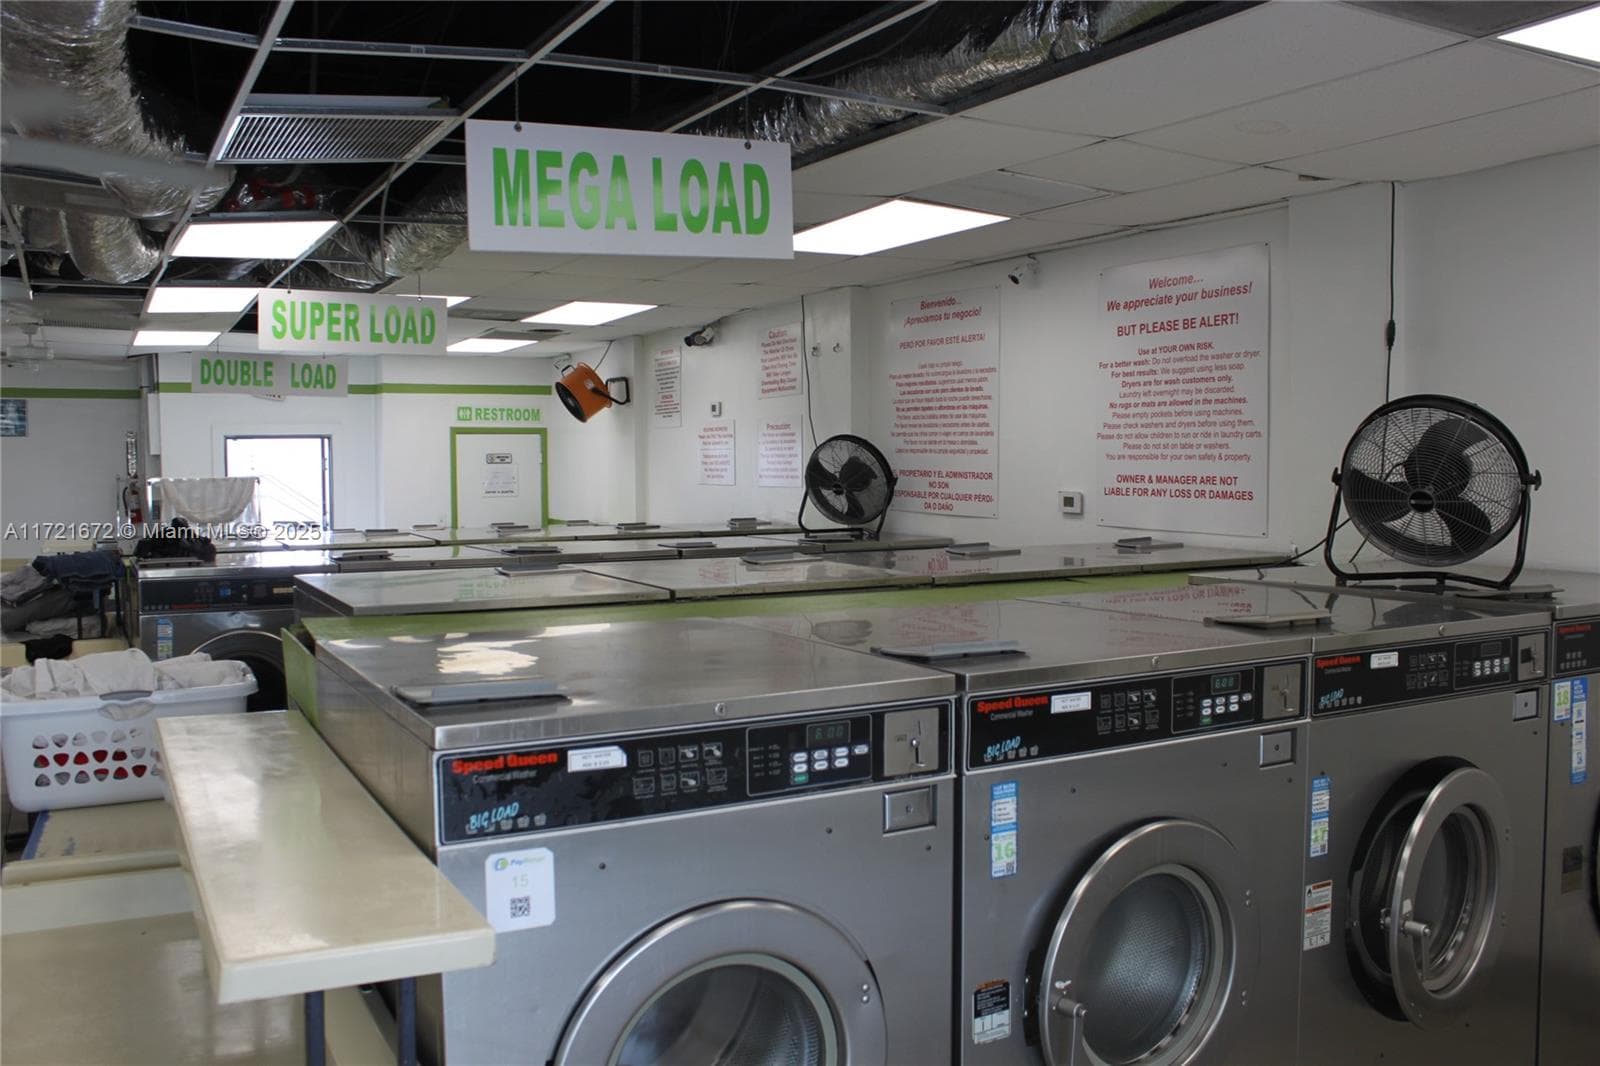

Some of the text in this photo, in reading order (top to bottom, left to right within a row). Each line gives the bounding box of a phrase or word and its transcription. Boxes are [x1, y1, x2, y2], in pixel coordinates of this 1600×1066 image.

[493, 147, 770, 235] MEGA LOAD
[1107, 281, 1252, 312] We appreciate your business!
[271, 299, 436, 344] SUPER LOAD
[1117, 313, 1239, 336] BUT PLEASE BE ALERT!
[1138, 347, 1150, 355] Use
[1151, 347, 1158, 355] at
[1159, 345, 1178, 354] YOUR
[1178, 344, 1196, 352] OWN
[1099, 361, 1108, 369] For
[1152, 357, 1161, 365] Do
[1200, 354, 1210, 362] the
[1215, 363, 1227, 371] less
[200, 358, 337, 389] DOUBLE LOAD
[1121, 380, 1142, 389] Dryers
[1182, 376, 1216, 385] customers
[1195, 387, 1203, 395] be
[1119, 402, 1132, 410] rugs
[1169, 398, 1194, 407] allowed
[1202, 397, 1213, 405] the
[474, 407, 541, 422] RESTROOM
[1217, 452, 1223, 461] &
[938, 470, 944, 478] EL
[1116, 474, 1239, 486] OWNER & MANAGER ARE NOT
[1104, 487, 1254, 501] LIABLE FOR ANY LOSS OR DAMAGES
[977, 698, 1013, 713] Speed
[1014, 695, 1049, 708] Queen
[986, 736, 1021, 758] BIG LOAD
[451, 754, 505, 776] Speed
[506, 751, 558, 769] Queen
[469, 802, 520, 830] BIG LOAD
[994, 841, 1014, 862] 16
[512, 873, 529, 888] 15
